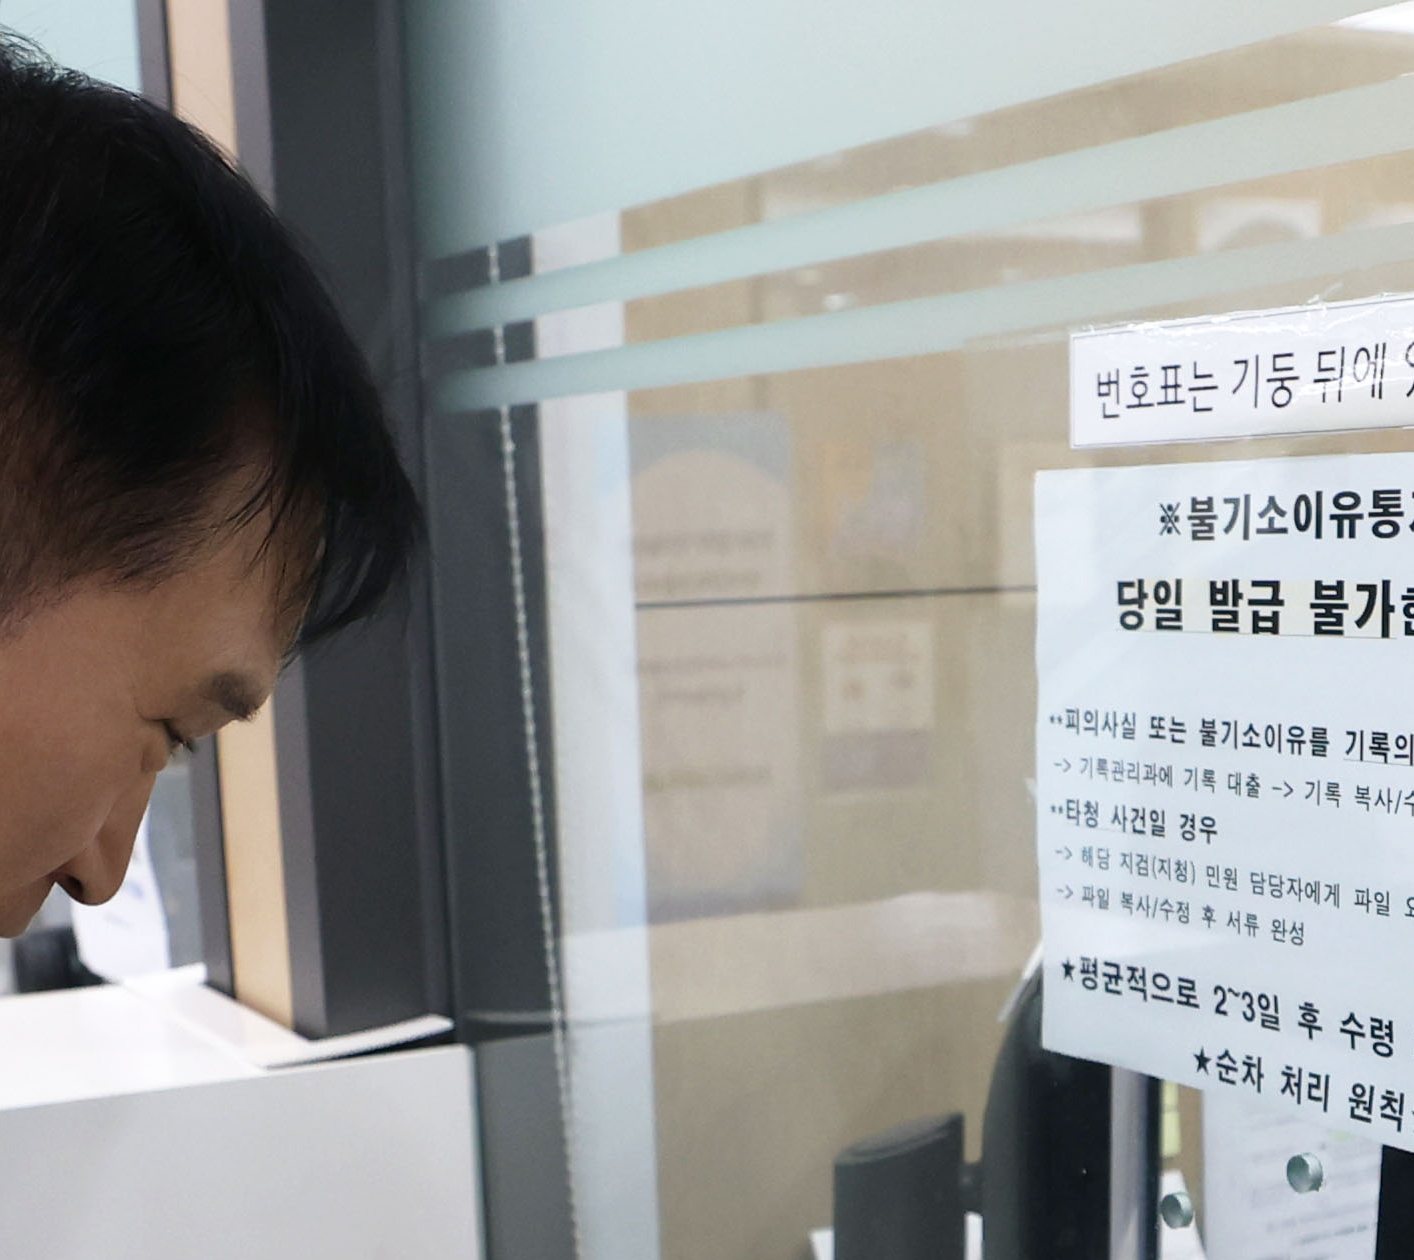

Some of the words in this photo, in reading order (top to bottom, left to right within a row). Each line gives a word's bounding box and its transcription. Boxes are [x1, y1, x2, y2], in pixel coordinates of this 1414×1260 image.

[1097, 361, 1219, 419] 번호표는
[1232, 352, 1300, 408] 기둥
[1313, 342, 1386, 403] 뒤에
[1117, 578, 1183, 632] 당일
[1209, 579, 1285, 635] 발급
[1148, 716, 1187, 744] 또는
[1199, 718, 1330, 757] 불기소이유를
[1345, 730, 1414, 766] 기록의
[1081, 758, 1172, 788] 기록관리과에
[1184, 768, 1216, 793] 기록
[1228, 772, 1261, 798] 대출
[1305, 780, 1341, 808] 기록
[1111, 805, 1165, 838] 사건일
[1180, 813, 1218, 844] 경우
[1082, 847, 1109, 870] 해당
[1121, 852, 1195, 885] 지검(지청)
[1206, 865, 1237, 891] 민원
[1250, 872, 1340, 909] 담당자에게
[1354, 888, 1390, 917] 파일
[1082, 886, 1109, 910] 파일
[1121, 892, 1189, 924] 복사/수정
[1202, 905, 1216, 928] 후
[1227, 911, 1259, 937] 서류
[1271, 919, 1304, 946] 완성
[1297, 1002, 1323, 1040] 후
[1339, 1012, 1394, 1058] 수령
[1281, 1065, 1330, 1113] 처리
